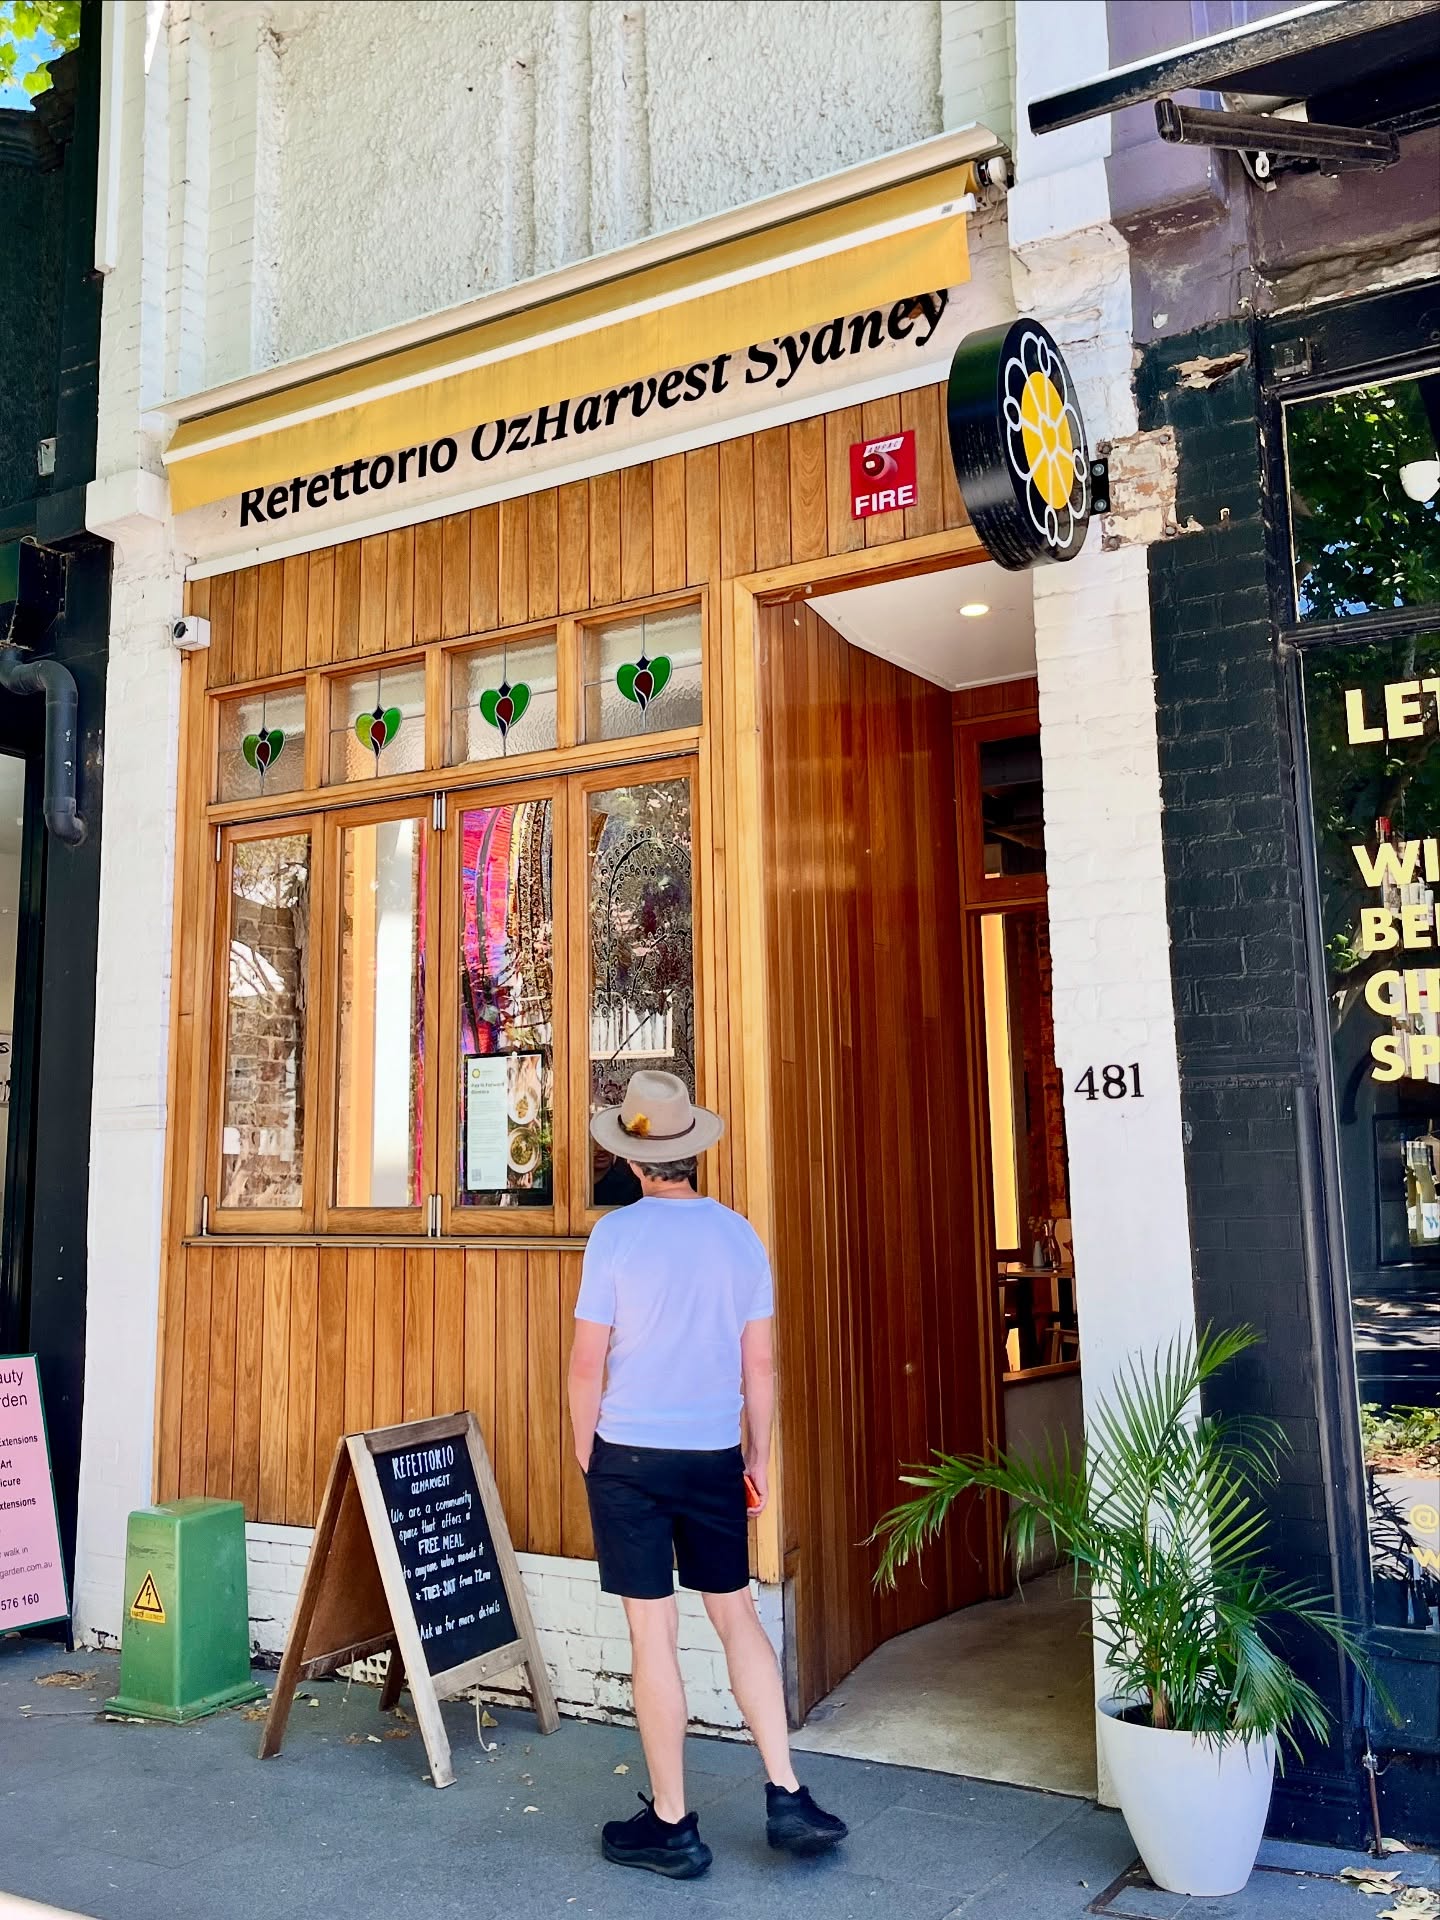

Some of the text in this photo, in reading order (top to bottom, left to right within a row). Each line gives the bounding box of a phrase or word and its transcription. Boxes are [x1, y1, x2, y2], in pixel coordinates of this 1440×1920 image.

[239, 288, 950, 528] Refettorio OzHarvest Sydney
[855, 484, 914, 516] FIRE
[1073, 1062, 1145, 1101] 481
[0, 1393, 28, 1408] den
[0, 1459, 12, 1469] Art
[392, 1445, 454, 1480] REFETTORIO
[411, 1474, 450, 1495] OZHARVEST
[390, 1489, 472, 1524] We are a community
[399, 1511, 471, 1546] space that offers a
[418, 1533, 464, 1556] FREE MEAL
[3, 1547, 20, 1558] walk
[403, 1541, 485, 1582] to anyone who needs it
[459, 1574, 473, 1588] from
[0, 1592, 39, 1611] 576 160
[420, 1599, 501, 1641] Ask us for more details
